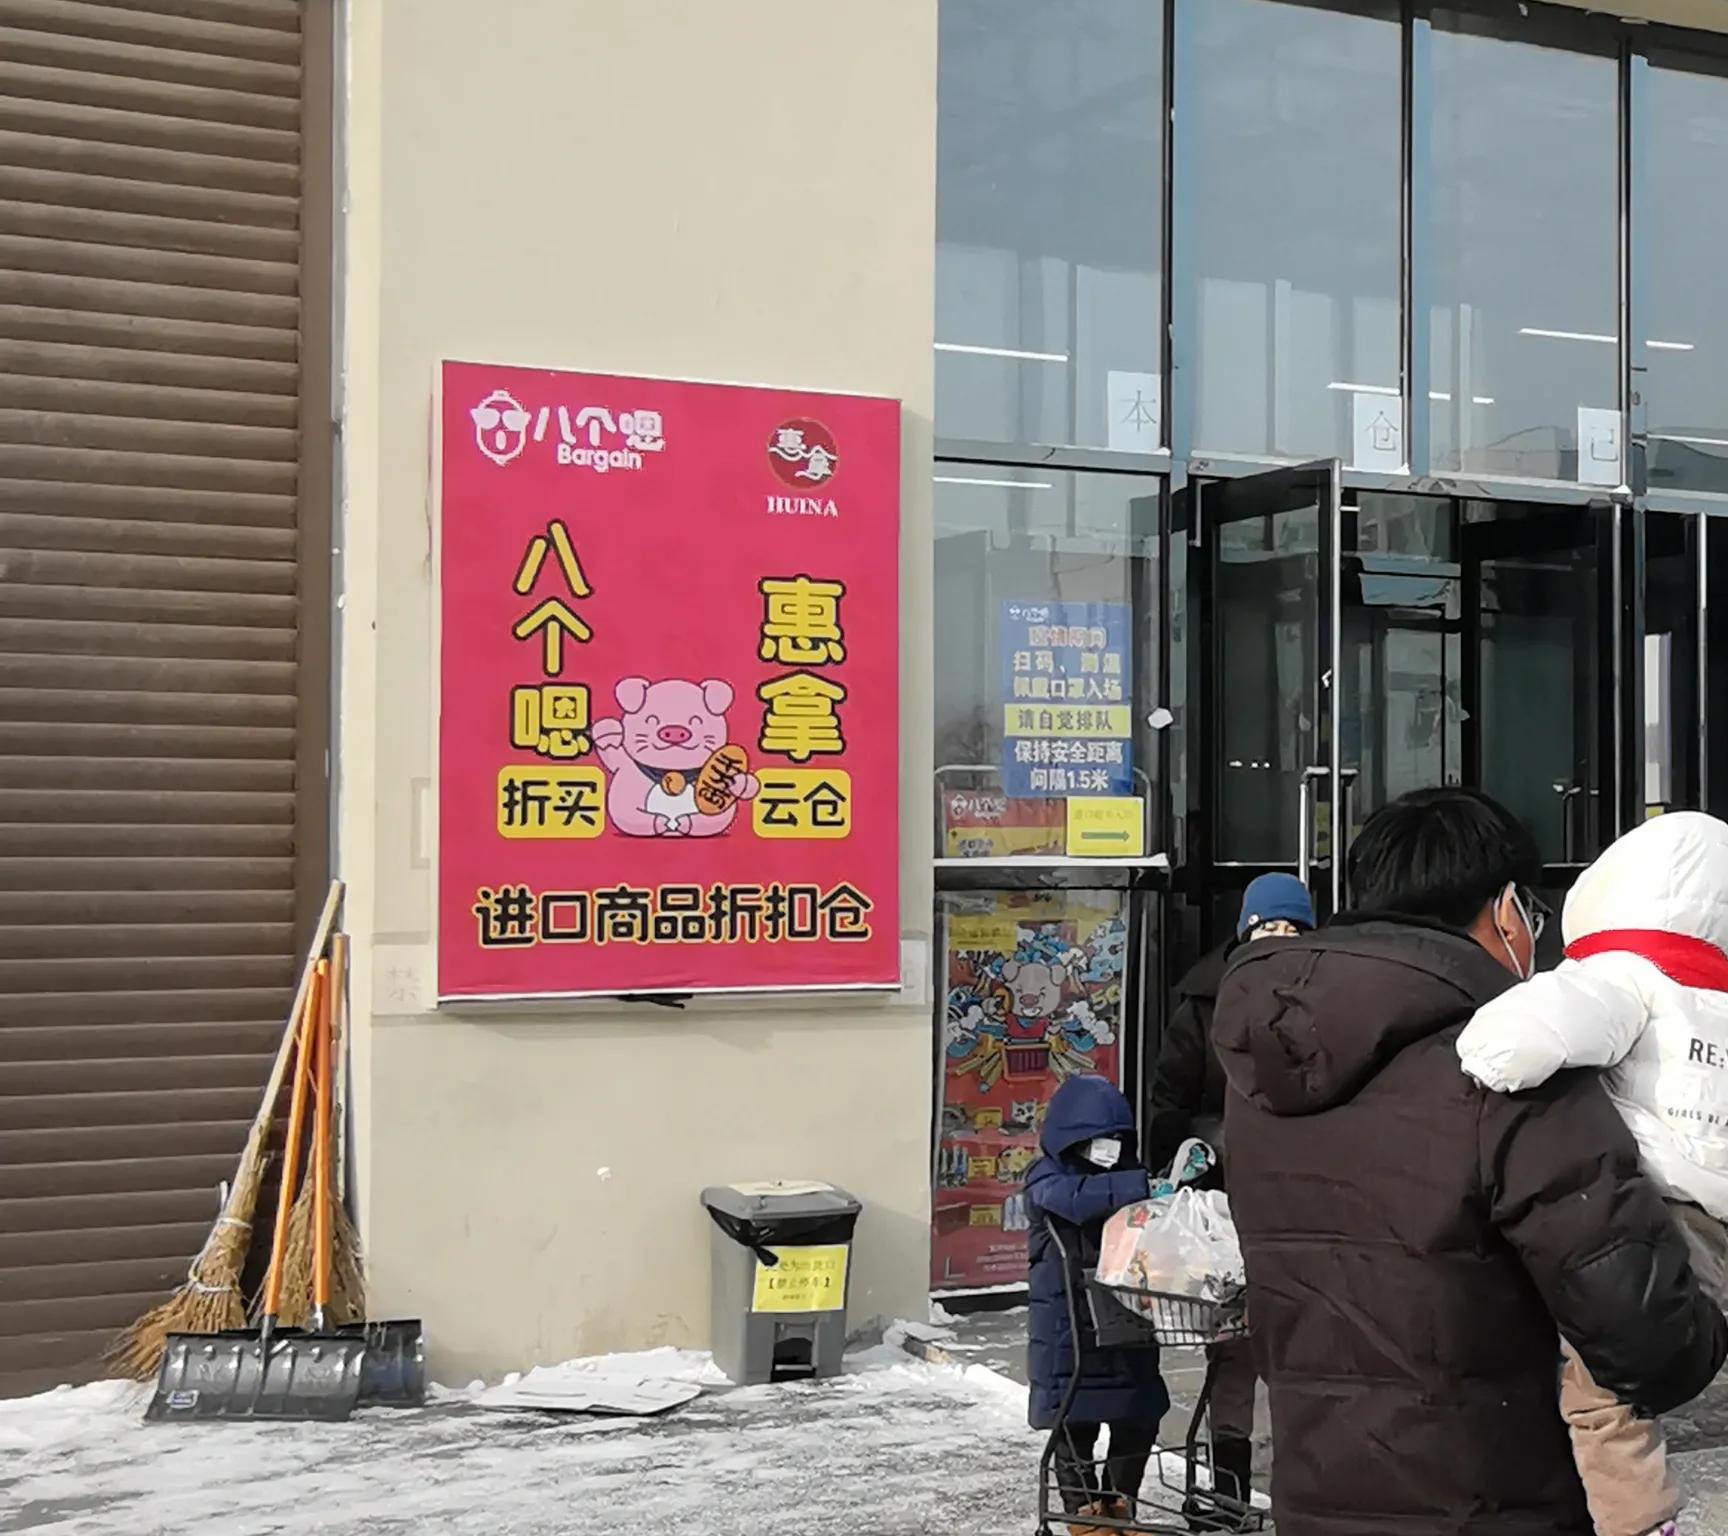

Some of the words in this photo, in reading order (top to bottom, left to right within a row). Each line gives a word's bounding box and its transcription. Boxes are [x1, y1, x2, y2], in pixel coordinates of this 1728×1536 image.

[1120, 389, 1157, 433] 本
[1364, 410, 1399, 452] 仓
[556, 442, 642, 473] Bargain
[766, 495, 839, 518] HUINA
[511, 519, 596, 761] 八个嗯
[757, 574, 848, 763] 惠拿
[1014, 739, 1124, 765] 保持安全距离
[502, 776, 602, 829] 折买
[760, 779, 850, 829] 云仓
[472, 882, 873, 949] 进口商品折扣仓
